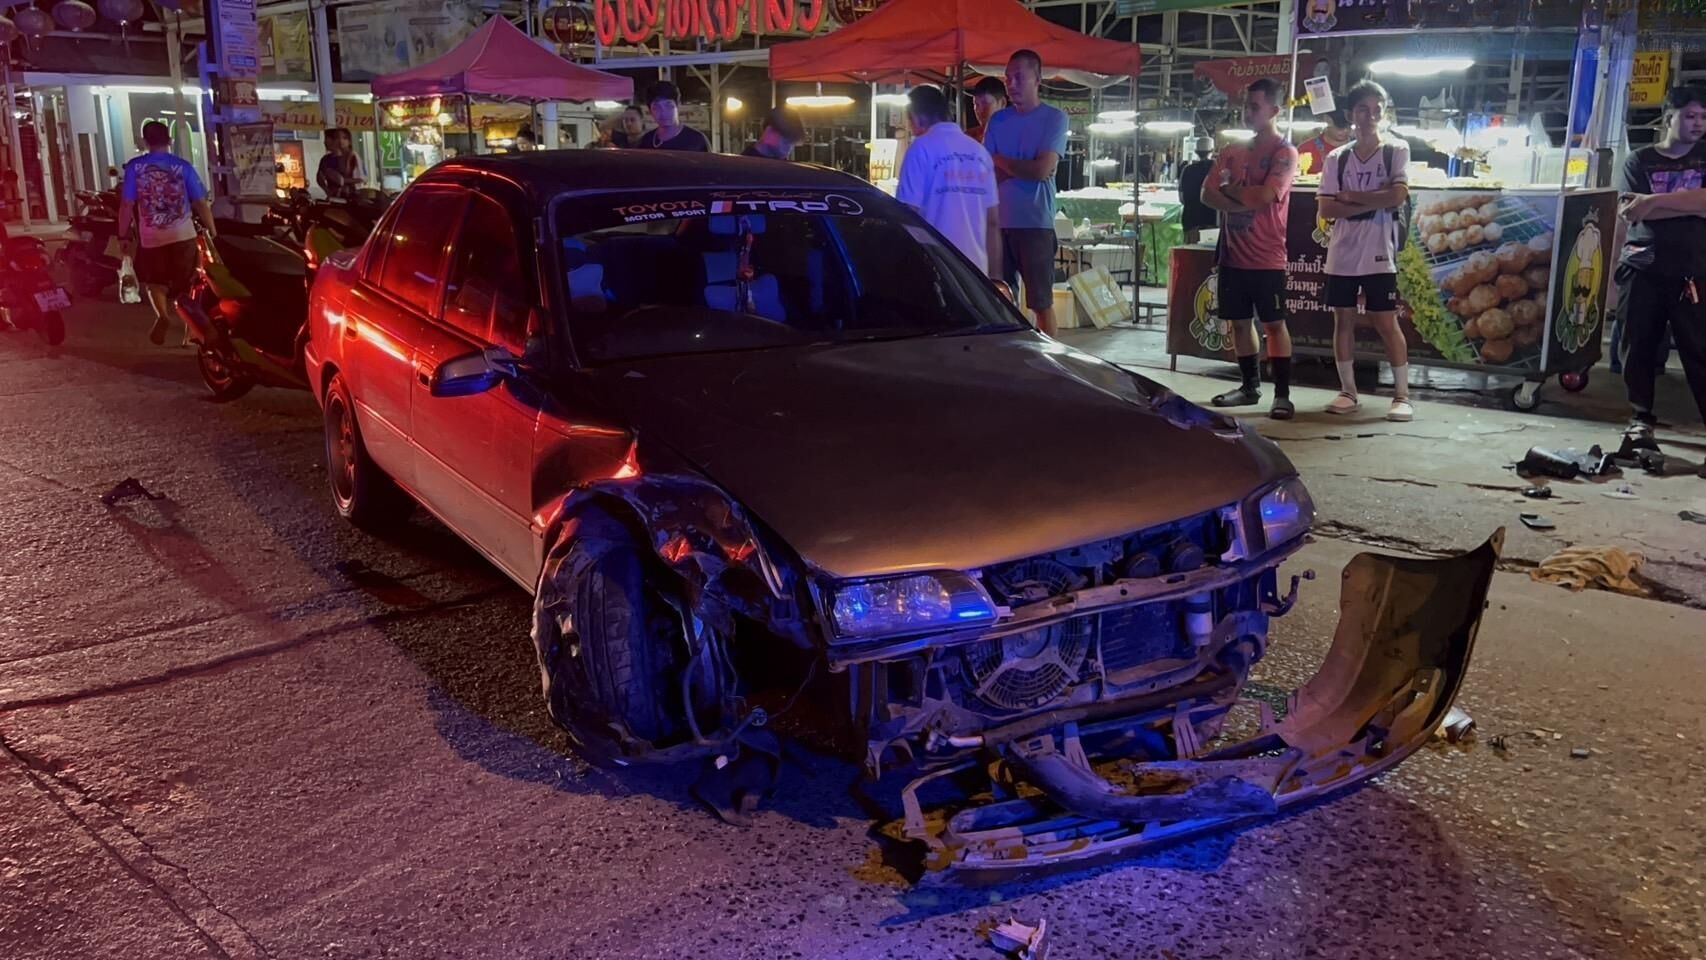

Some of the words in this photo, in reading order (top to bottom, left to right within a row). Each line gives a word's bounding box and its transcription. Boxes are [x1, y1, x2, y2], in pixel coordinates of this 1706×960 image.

[1356, 171, 1372, 187] 77
[612, 200, 706, 215] TOYOTA
[736, 200, 829, 213] TRD
[624, 212, 665, 223] MOTOR
[671, 208, 706, 218] SPORT
